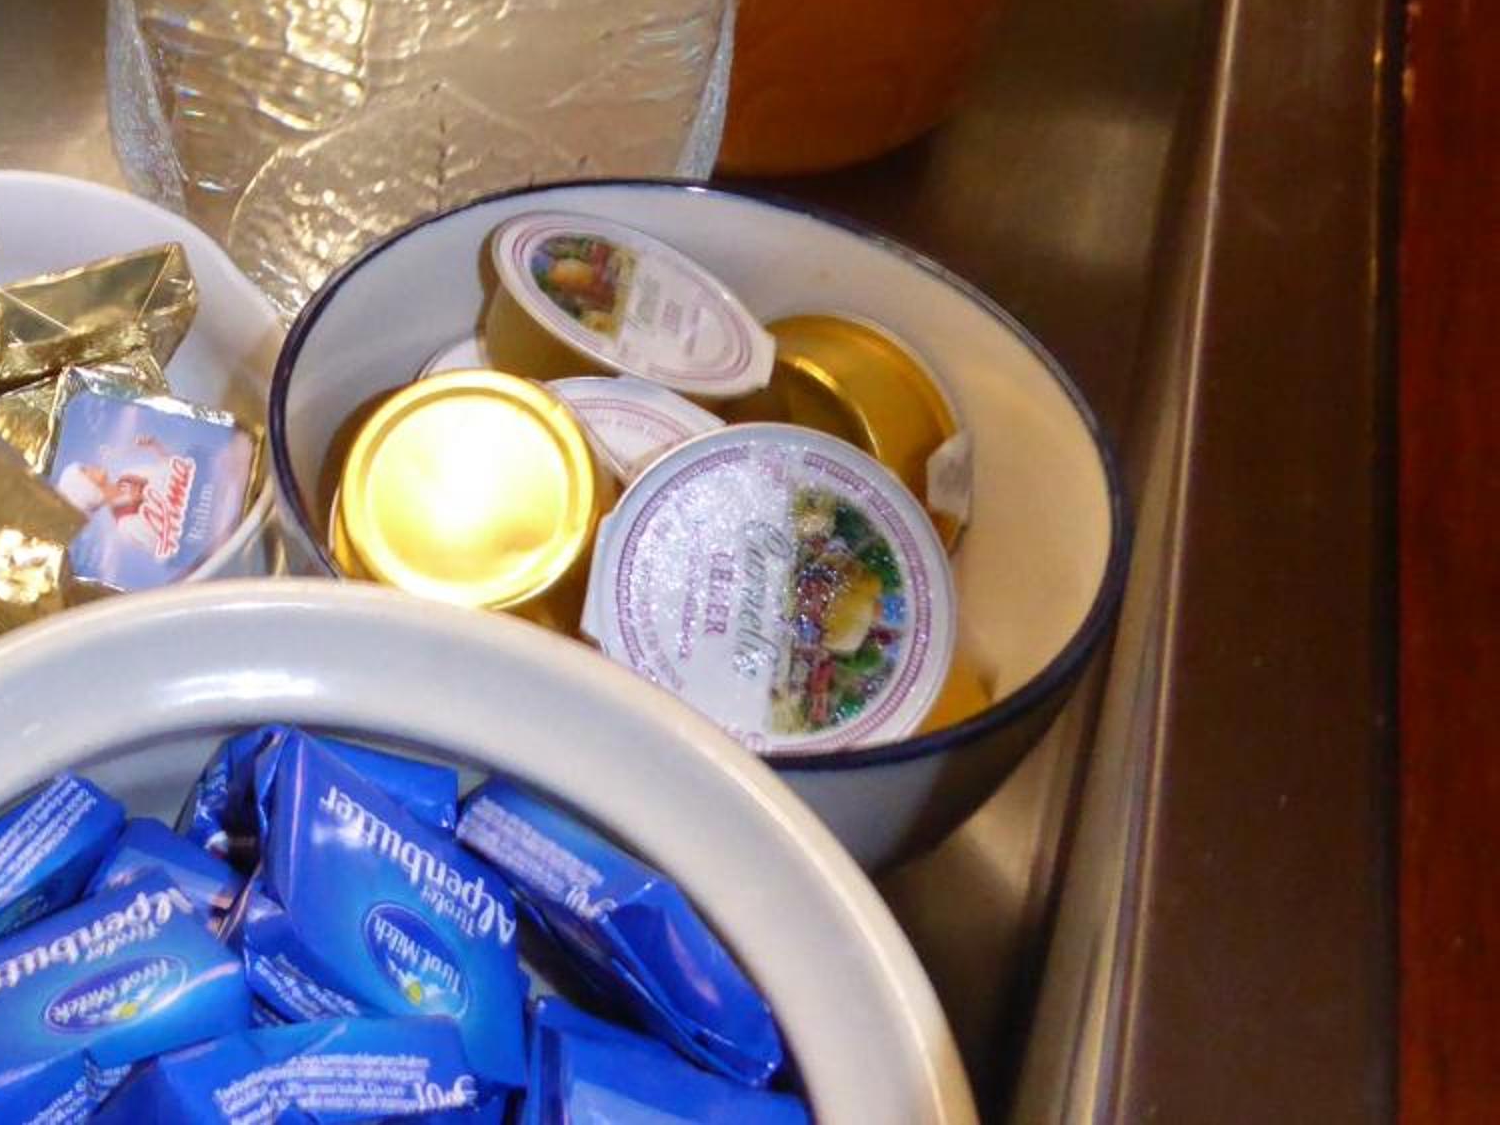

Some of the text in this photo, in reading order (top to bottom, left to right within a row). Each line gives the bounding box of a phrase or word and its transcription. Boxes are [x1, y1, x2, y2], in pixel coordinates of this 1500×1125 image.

[318, 784, 517, 945] Alpenbutter
[420, 884, 476, 938] Tiroler
[373, 913, 421, 964] Milch
[49, 958, 170, 1025] Tirol Milch
[419, 947, 463, 994] Tirol
